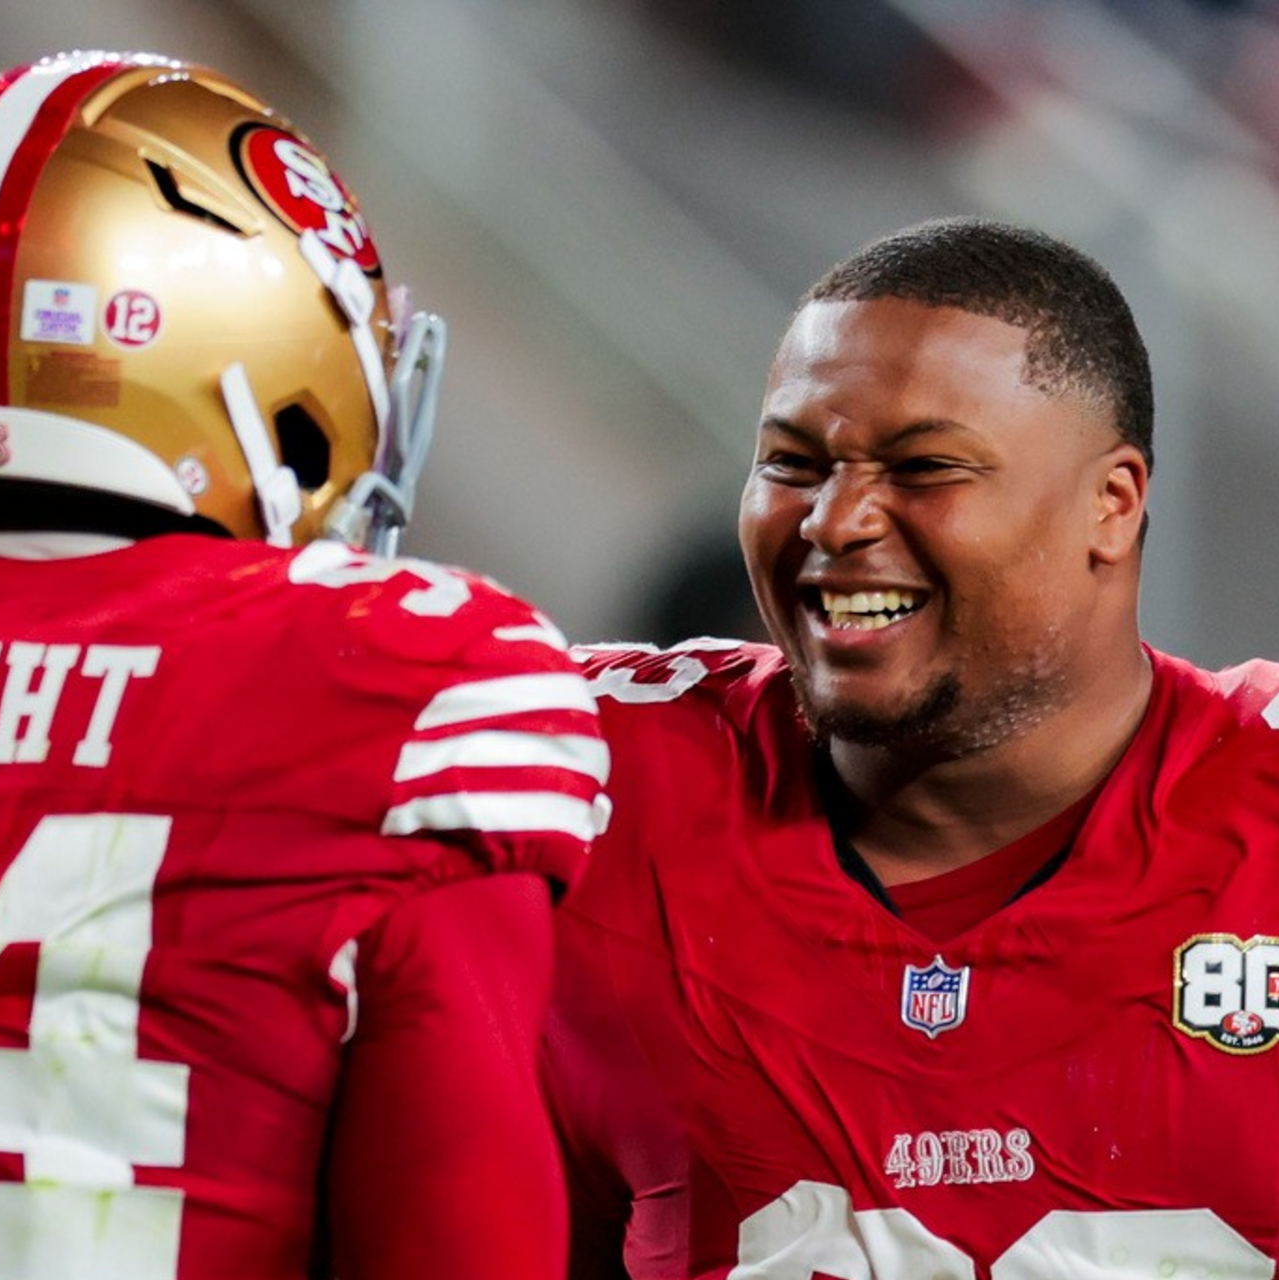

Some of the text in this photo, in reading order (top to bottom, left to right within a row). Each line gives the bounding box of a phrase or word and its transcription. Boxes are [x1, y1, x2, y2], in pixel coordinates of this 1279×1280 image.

[109, 294, 155, 342] 12
[911, 992, 953, 1024] NFL
[885, 1127, 1035, 1189] 49ERS
